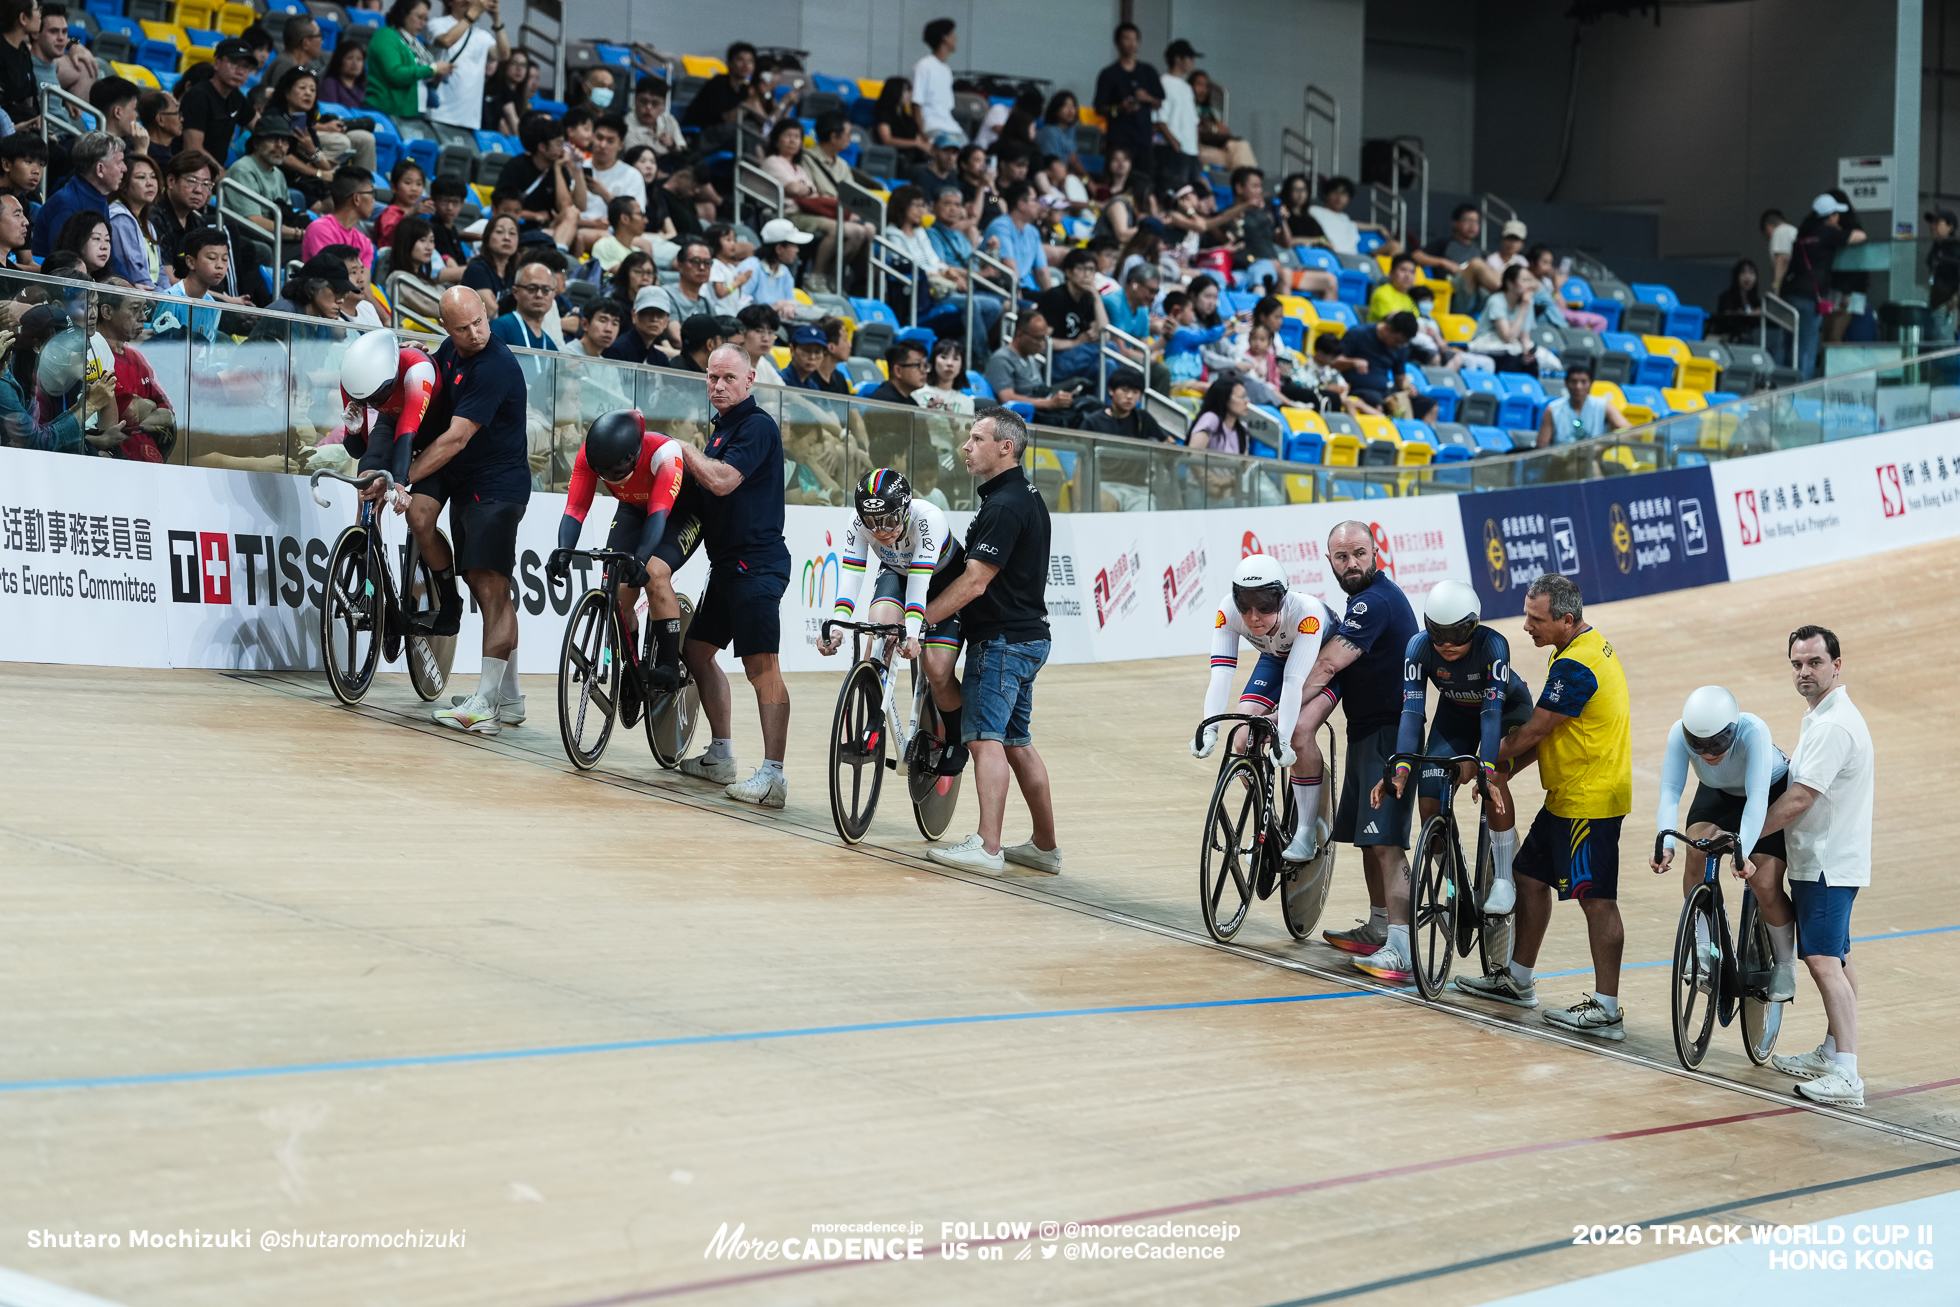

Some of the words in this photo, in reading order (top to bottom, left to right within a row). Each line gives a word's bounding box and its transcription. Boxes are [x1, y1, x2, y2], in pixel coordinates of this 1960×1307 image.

[668, 472, 682, 500] ANTA
[2, 506, 153, 561] 活動事務委員會
[677, 513, 703, 556] CHINA
[0, 567, 18, 594] ts
[22, 565, 74, 598] Events
[78, 568, 157, 604] Committee
[235, 534, 340, 609] TISS
[1422, 768, 1445, 779] SUAREZ
[1262, 773, 1276, 838] LOTUS
